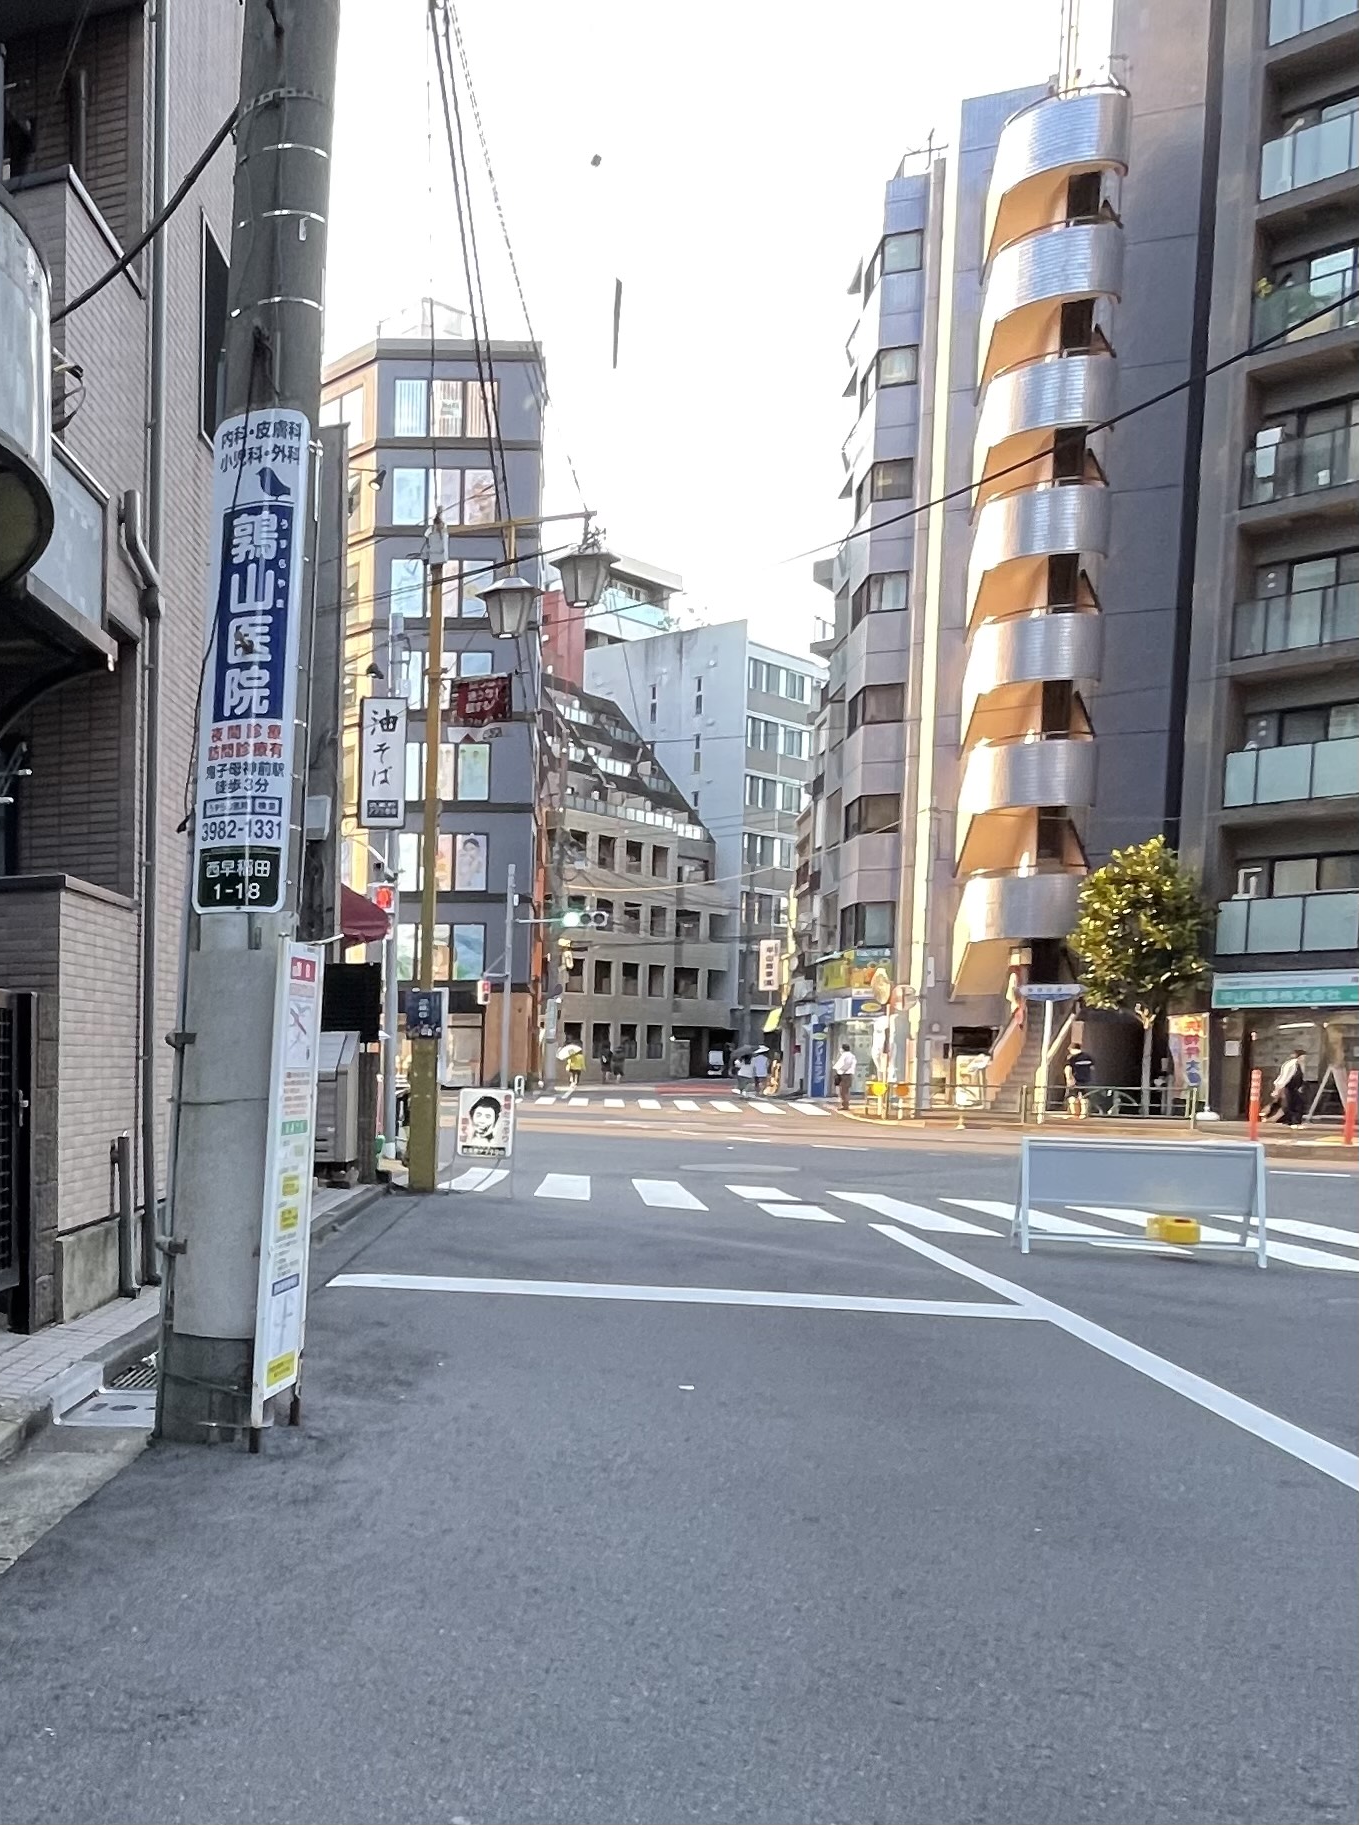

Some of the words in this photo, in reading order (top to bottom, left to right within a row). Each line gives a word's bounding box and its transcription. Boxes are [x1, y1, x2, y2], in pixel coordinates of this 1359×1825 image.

[370, 708, 399, 787] 油そば
[201, 819, 282, 842] 3982-1331
[206, 859, 271, 878] 西早稲田
[213, 882, 261, 900] 1-18
